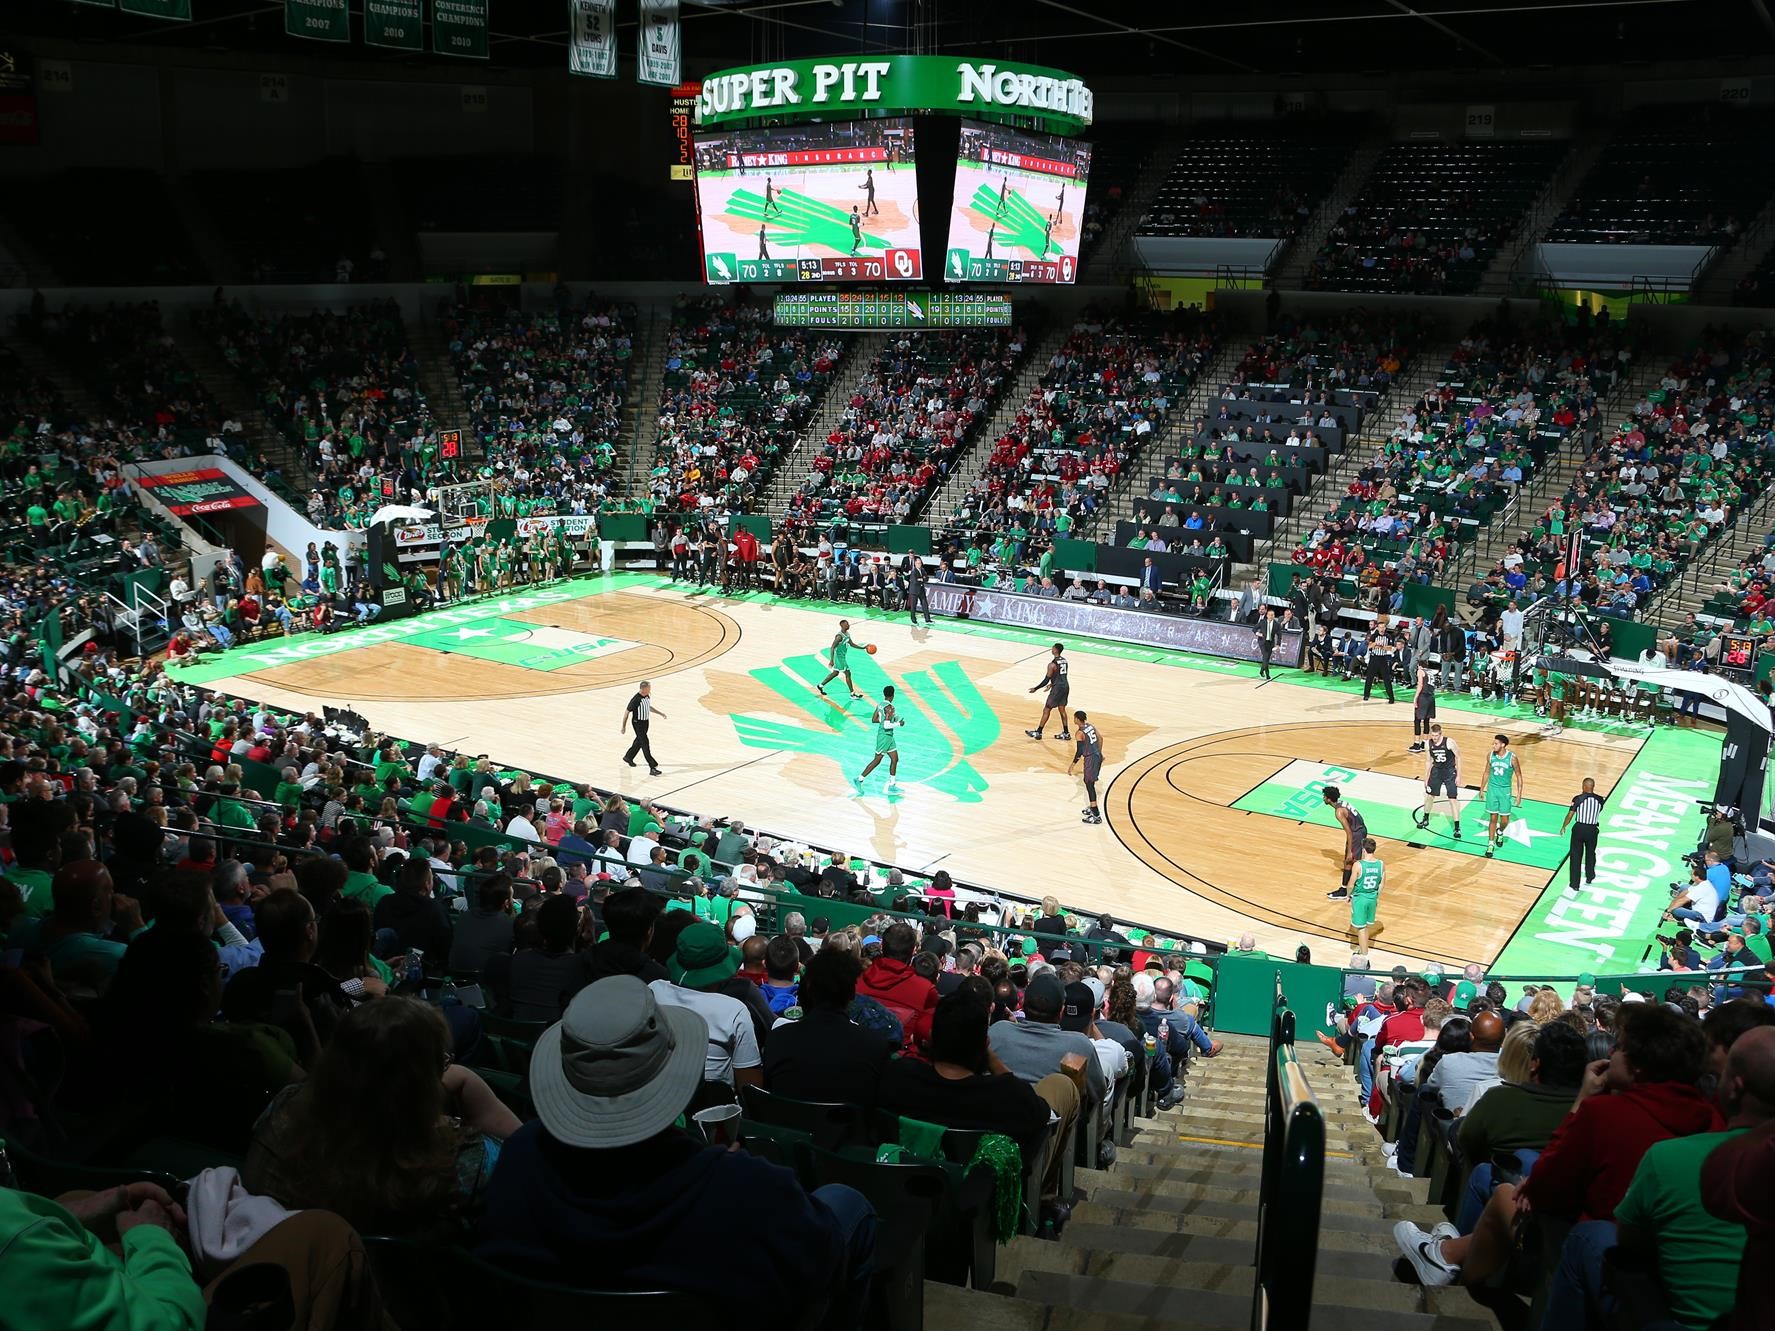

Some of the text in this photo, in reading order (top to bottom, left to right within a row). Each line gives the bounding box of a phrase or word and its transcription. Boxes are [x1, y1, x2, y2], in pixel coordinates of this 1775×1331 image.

[369, 3, 419, 18] CHAMPIONS
[436, 0, 484, 15] CONFERENCE
[580, 1, 606, 14] KENNETH
[305, 17, 330, 30] 2007
[436, 14, 485, 27] CHAMPIONS
[586, 14, 600, 31] 52
[384, 26, 404, 38] 2010
[584, 32, 602, 43] LYONS
[656, 26, 662, 42] 5
[451, 36, 472, 47] 2010
[652, 44, 668, 54] DAVIS
[44, 70, 69, 82] 214
[262, 76, 286, 88] 214
[702, 62, 891, 116] SUPER PIT
[956, 63, 1069, 112] NORTH
[1721, 88, 1749, 99] 220
[672, 116, 688, 126] 28
[1468, 114, 1492, 124] 219
[677, 127, 688, 138] 10
[680, 140, 688, 150] 2
[680, 152, 688, 162] 2
[768, 153, 788, 166] KING
[742, 264, 758, 278] 70
[802, 261, 817, 269] 5:13
[864, 262, 880, 276] 70
[971, 264, 982, 276] 70
[801, 271, 810, 280] 28
[851, 268, 856, 276] 3
[1046, 266, 1056, 280] 70
[442, 442, 457, 457] 28
[1001, 596, 1046, 626] KING
[240, 590, 572, 667] NORTH TEXAS
[1080, 640, 1153, 658] NORTH
[1730, 640, 1752, 651] 5:13
[1728, 650, 1746, 664] 28
[1613, 664, 1644, 675] SPALDING
[1088, 730, 1097, 744] 15
[1434, 754, 1446, 763] 35
[1494, 767, 1504, 776] 24
[1534, 771, 1712, 960] MEAN GREEN
[1363, 875, 1378, 890] 55
